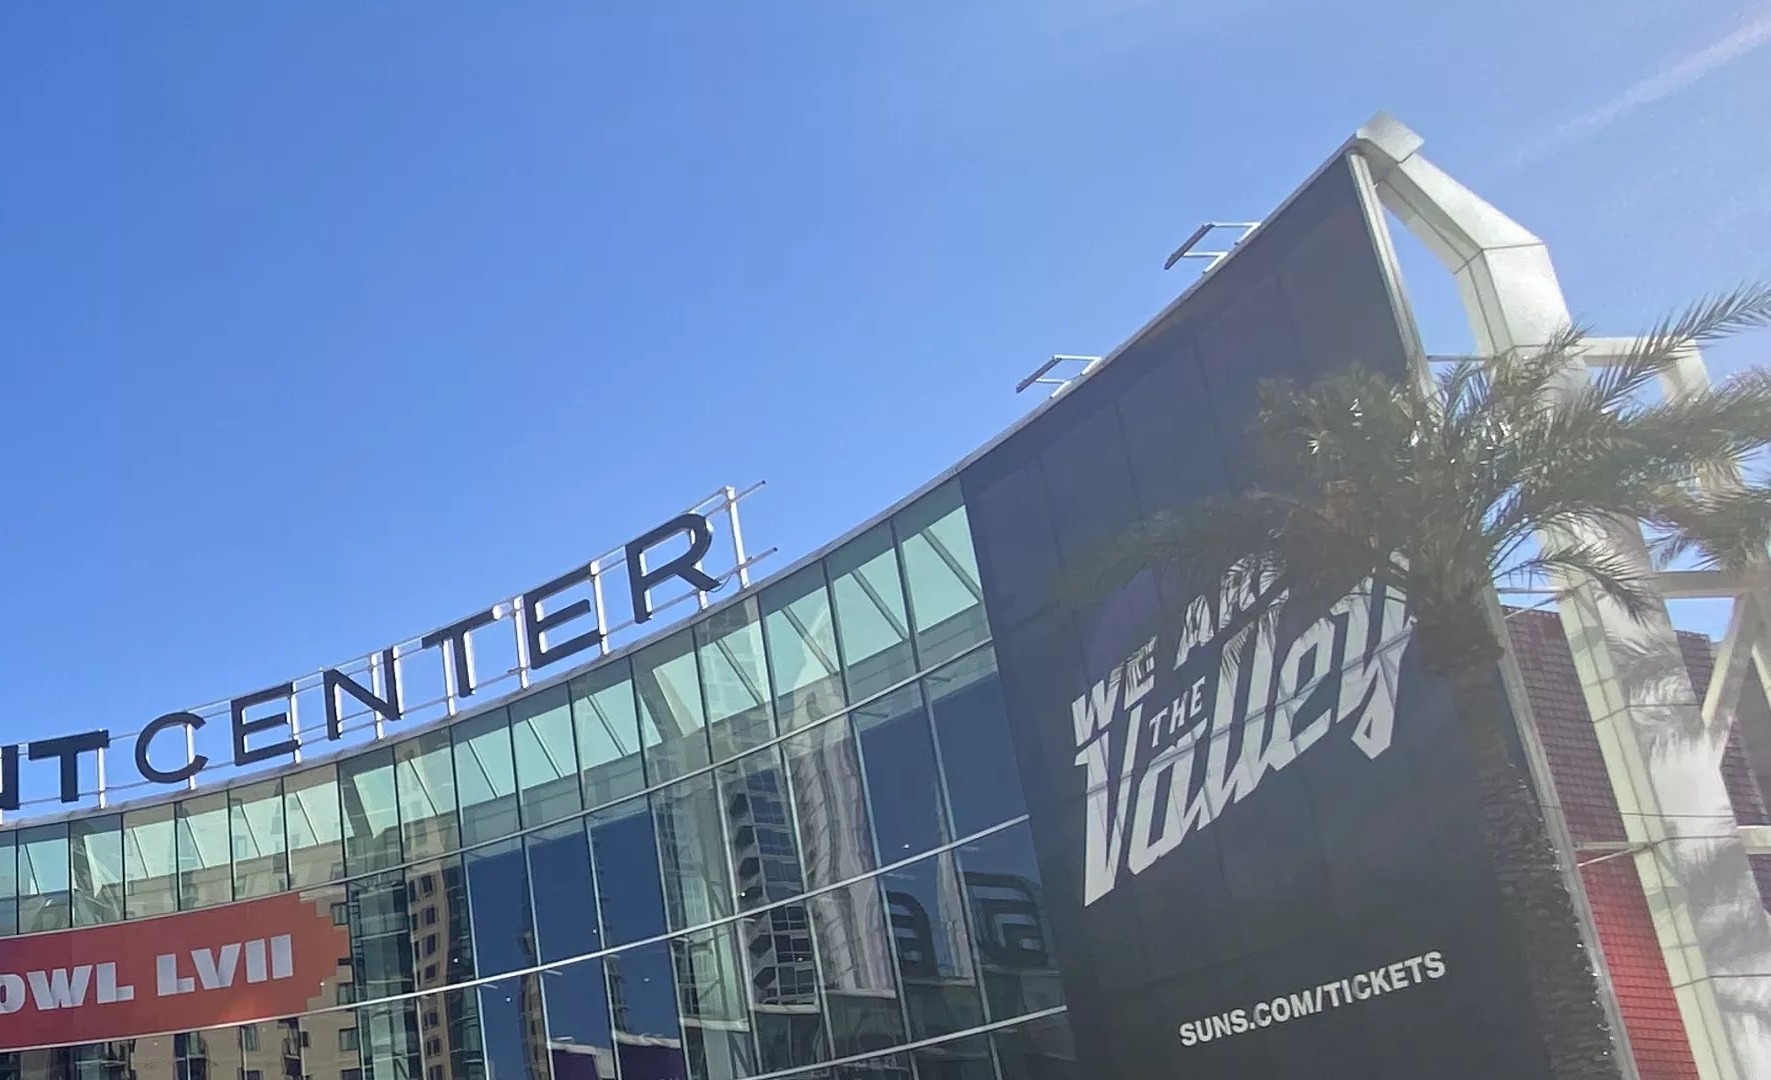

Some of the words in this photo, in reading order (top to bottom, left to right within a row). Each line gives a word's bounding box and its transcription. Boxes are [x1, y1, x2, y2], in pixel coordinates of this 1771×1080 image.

[135, 513, 722, 784] CENTER
[1071, 635, 1157, 747] WE
[1149, 676, 1206, 748] THE
[156, 934, 293, 996] LVII
[1179, 951, 1446, 1046] SUNS.COM/TICKETS
